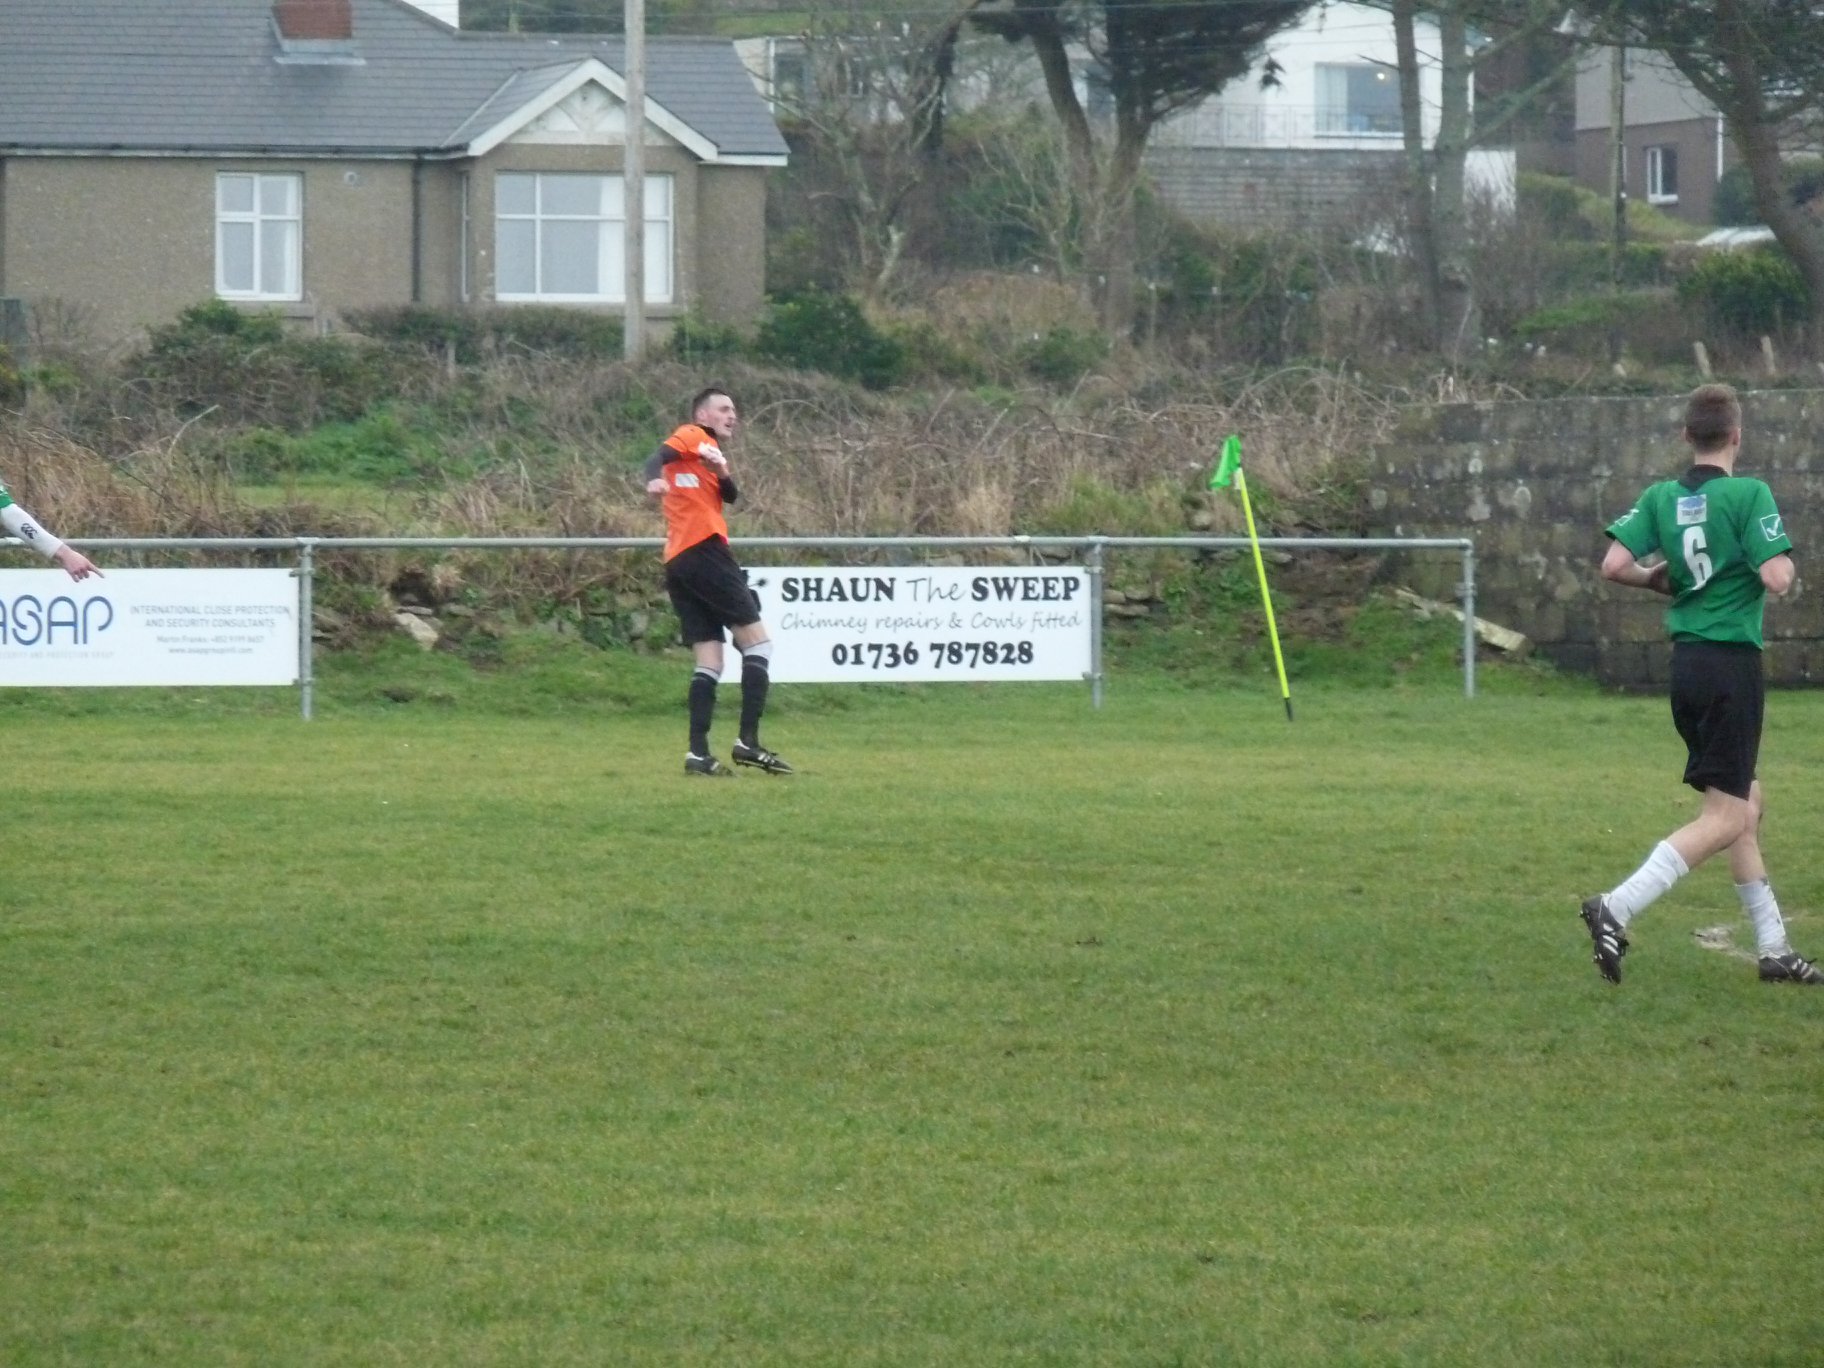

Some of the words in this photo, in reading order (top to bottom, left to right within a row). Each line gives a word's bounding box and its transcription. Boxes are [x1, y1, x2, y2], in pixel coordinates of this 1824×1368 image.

[1682, 525, 1713, 591] 6
[781, 576, 896, 602] SHAUN
[906, 576, 966, 603] The
[971, 576, 1080, 602] SWEEP
[0, 594, 114, 646] SAP
[130, 605, 201, 614] INTERNATIONAL
[204, 605, 233, 614] CLOSE
[235, 605, 290, 614] PROTECTION
[145, 618, 165, 627] AND
[167, 618, 209, 627] SECURITY
[212, 618, 275, 627] CONSULTANTS
[781, 612, 868, 634] Chimney
[875, 611, 942, 634] repairs
[948, 611, 963, 629] &
[971, 611, 1024, 630] Cowls
[1030, 610, 1082, 633] fitted
[831, 641, 919, 669] 01736
[929, 641, 1034, 669] 787828
